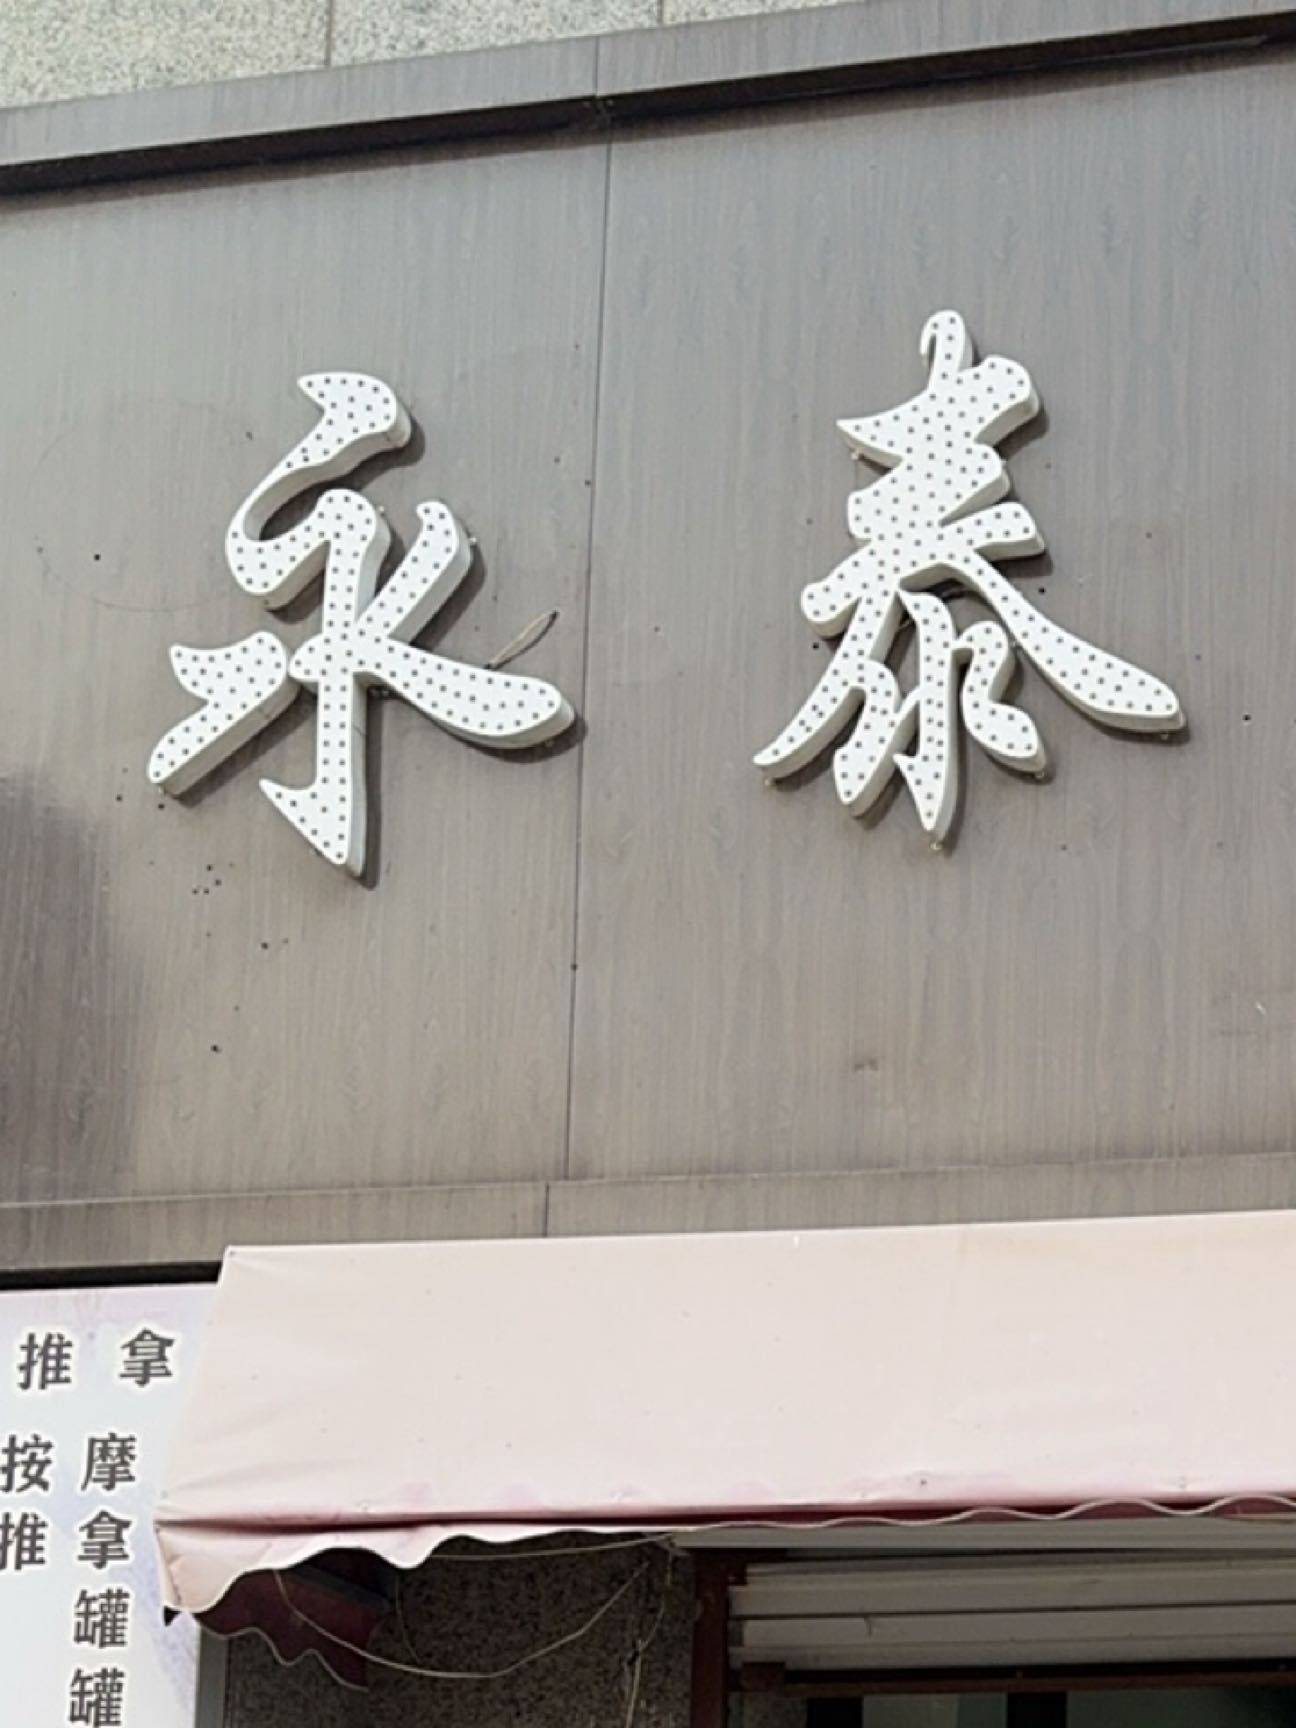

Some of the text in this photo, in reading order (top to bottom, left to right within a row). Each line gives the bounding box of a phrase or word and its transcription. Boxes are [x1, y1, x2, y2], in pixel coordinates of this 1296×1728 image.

[18, 1327, 175, 1391] 推拿
[0, 1432, 137, 1493] 按摩
[0, 1509, 133, 1570] 推拿
